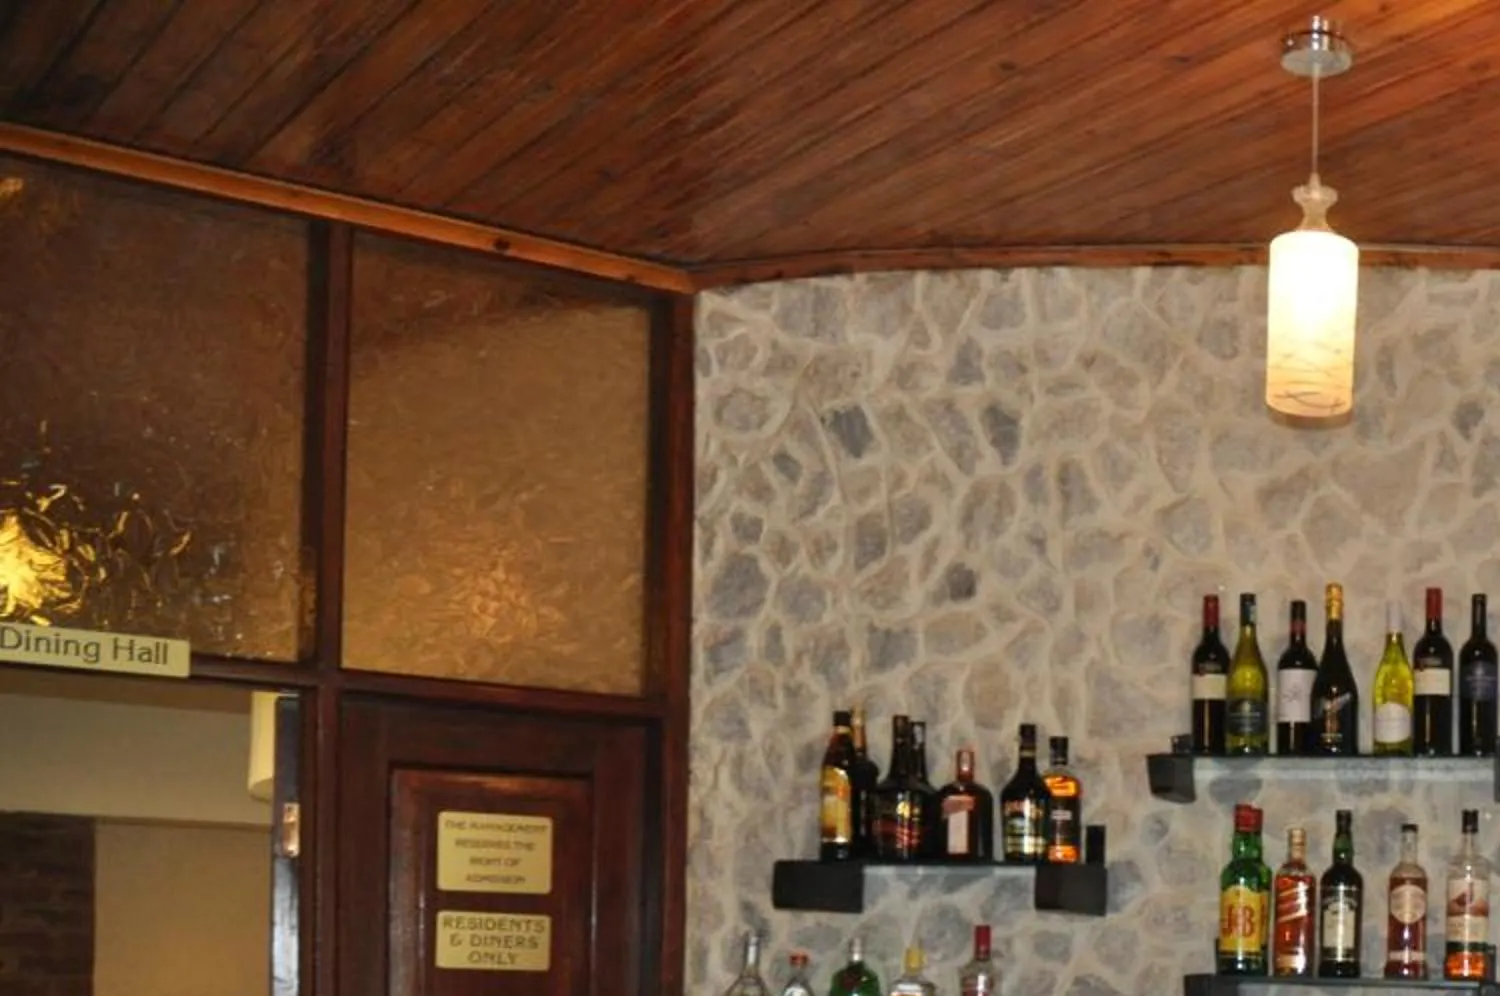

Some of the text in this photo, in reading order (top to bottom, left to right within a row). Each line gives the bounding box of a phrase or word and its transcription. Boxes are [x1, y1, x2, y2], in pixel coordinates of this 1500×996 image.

[0, 626, 169, 665] Dining Hall
[443, 915, 546, 933] RESIDENTS
[470, 933, 538, 949] DINERS
[466, 950, 518, 965] ONLY
